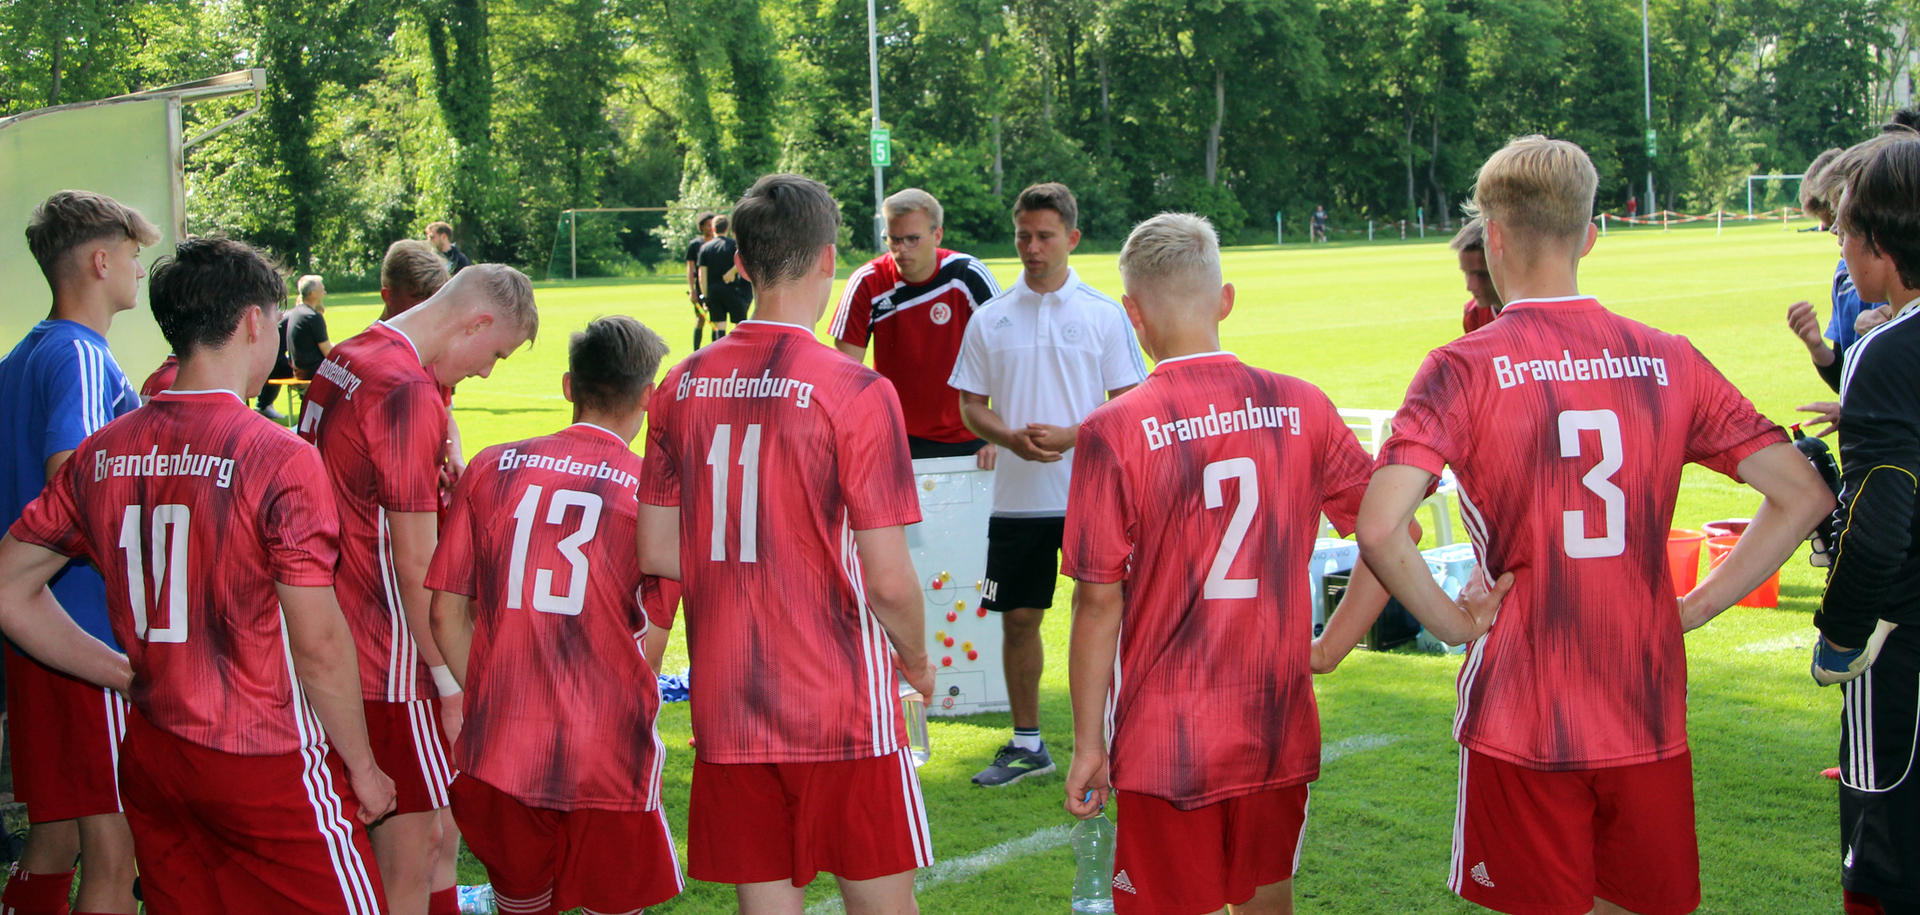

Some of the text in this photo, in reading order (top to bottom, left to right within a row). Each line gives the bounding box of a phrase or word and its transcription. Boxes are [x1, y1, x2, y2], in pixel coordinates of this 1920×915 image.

[876, 143, 886, 162] 5
[317, 355, 362, 401] andenburg
[676, 368, 815, 409] Brandenburg
[1493, 349, 1669, 390] Brandenburg
[1141, 397, 1301, 451] Brandenburg
[94, 444, 236, 489] Brandenburg
[1557, 408, 1626, 559] 3
[706, 423, 762, 563] 11
[506, 484, 603, 616] 13
[1203, 456, 1259, 600] 2
[119, 503, 191, 643] 10
[982, 578, 998, 602] LH
